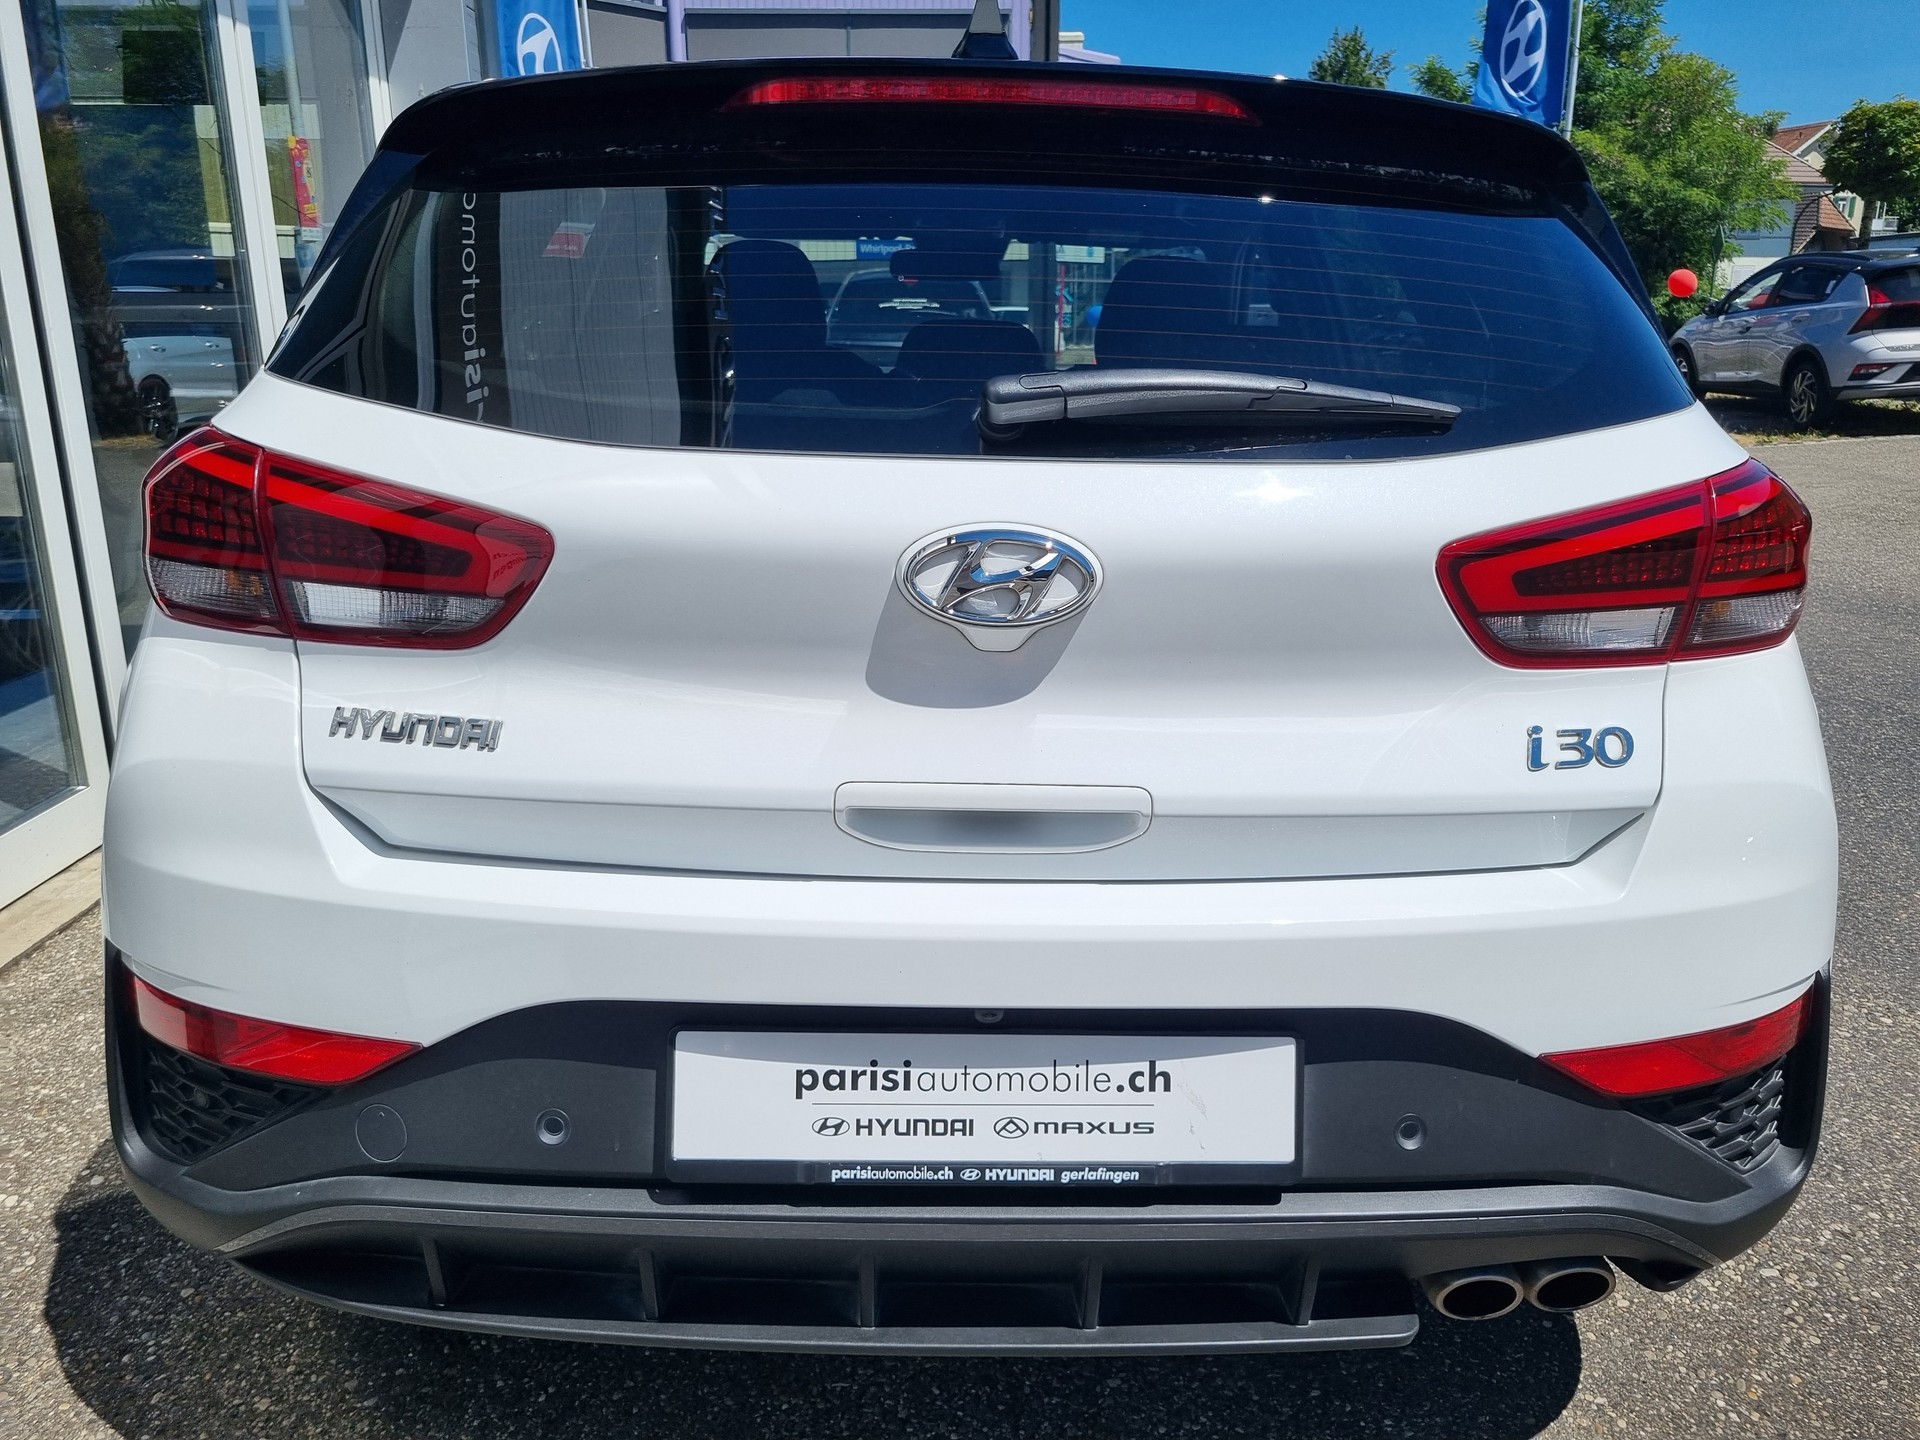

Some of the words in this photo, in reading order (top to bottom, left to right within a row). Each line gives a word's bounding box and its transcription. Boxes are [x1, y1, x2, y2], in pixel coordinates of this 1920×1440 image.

[329, 706, 503, 752] HYUNDAI
[1527, 725, 1635, 772] i30
[795, 1059, 1172, 1100] parisiautomobile.ch
[855, 1118, 974, 1137] HYUNDAI
[1033, 1121, 1155, 1135] MAXUS
[831, 1166, 954, 1183] parisiautomobile.ch
[985, 1168, 1055, 1181] HYUNDAI
[1060, 1167, 1140, 1184] gerlafingen
